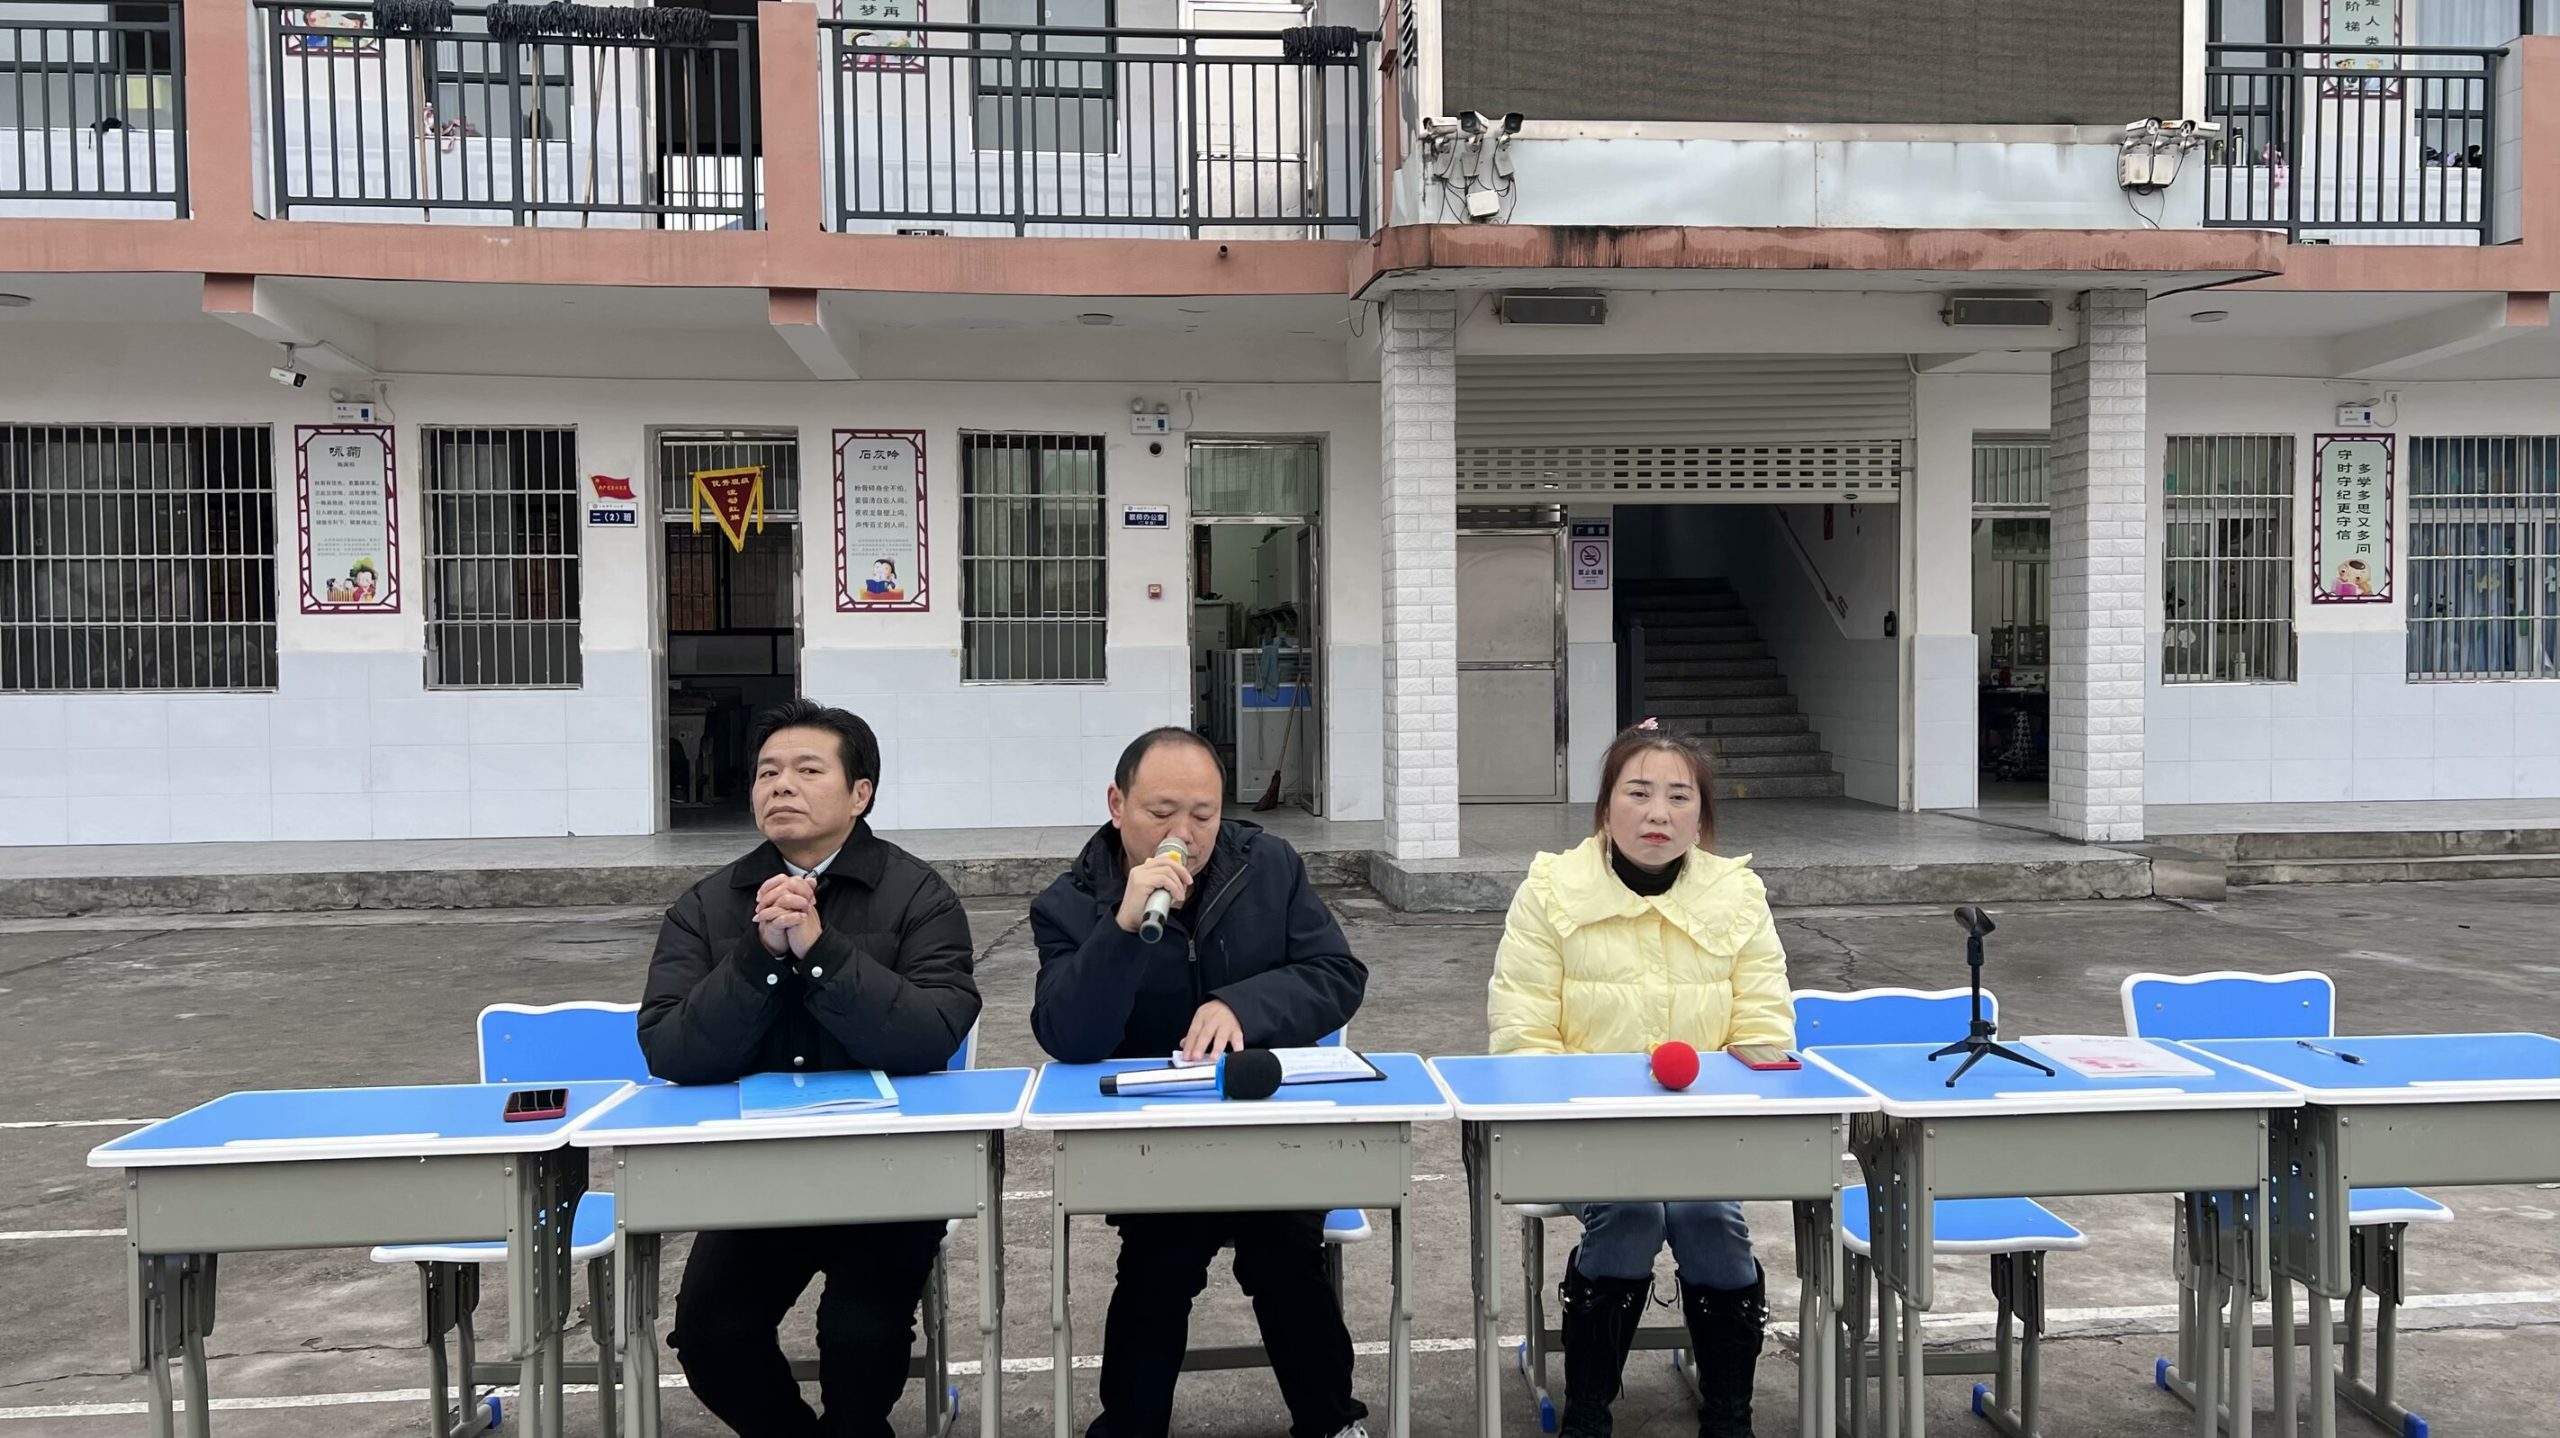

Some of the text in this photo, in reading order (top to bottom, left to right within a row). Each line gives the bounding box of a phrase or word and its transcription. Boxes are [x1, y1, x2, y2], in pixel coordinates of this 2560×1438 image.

[2344, 1, 2360, 31] 阶梯
[859, 449, 900, 461] 石灰吟
[2336, 449, 2352, 540] 守时守纪更守信
[2356, 463, 2372, 554] 多学多思又多问
[1129, 513, 1164, 521] 教师办公室
